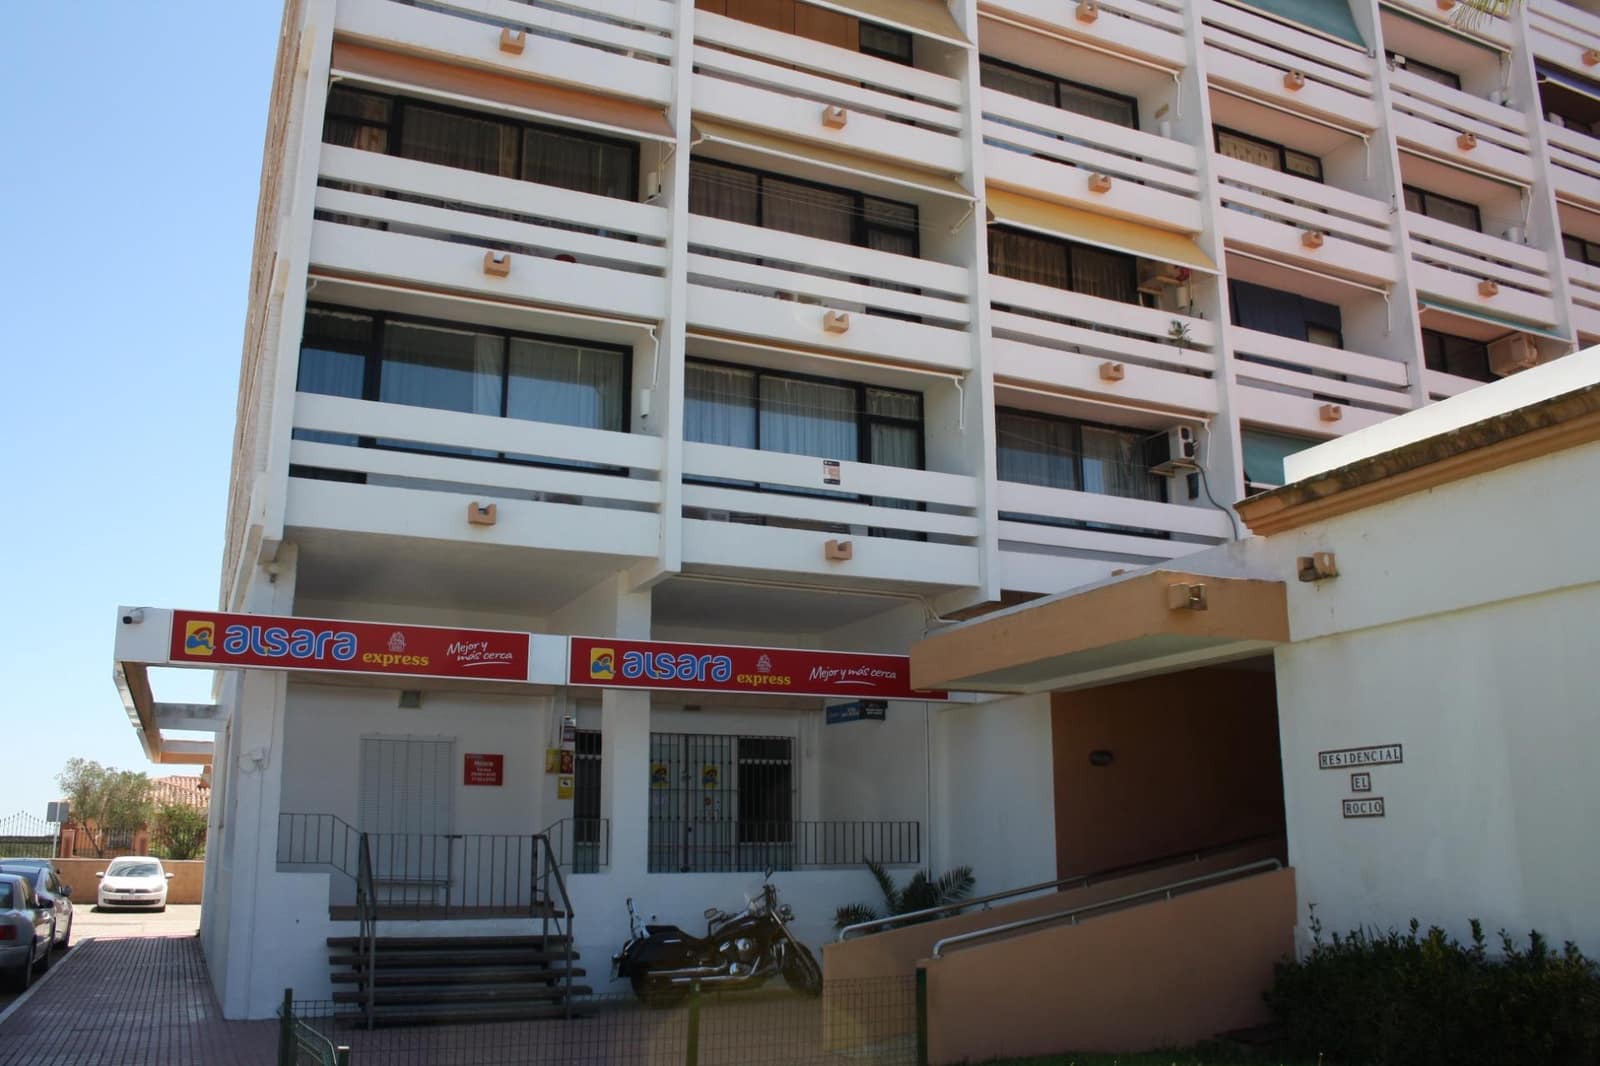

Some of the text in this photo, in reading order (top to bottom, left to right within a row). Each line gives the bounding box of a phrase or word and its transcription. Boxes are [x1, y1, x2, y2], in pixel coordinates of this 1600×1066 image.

[223, 624, 358, 661] alsara
[446, 641, 488, 656] Mejor y
[362, 653, 430, 667] express
[456, 650, 513, 661] más cerca
[622, 651, 732, 682] alsara
[809, 665, 897, 681] Mejor y más cerca
[736, 673, 792, 686] express
[1321, 748, 1400, 766] RESIDENCIAL
[1354, 777, 1368, 788] EL
[1345, 801, 1382, 814] ROCIO
